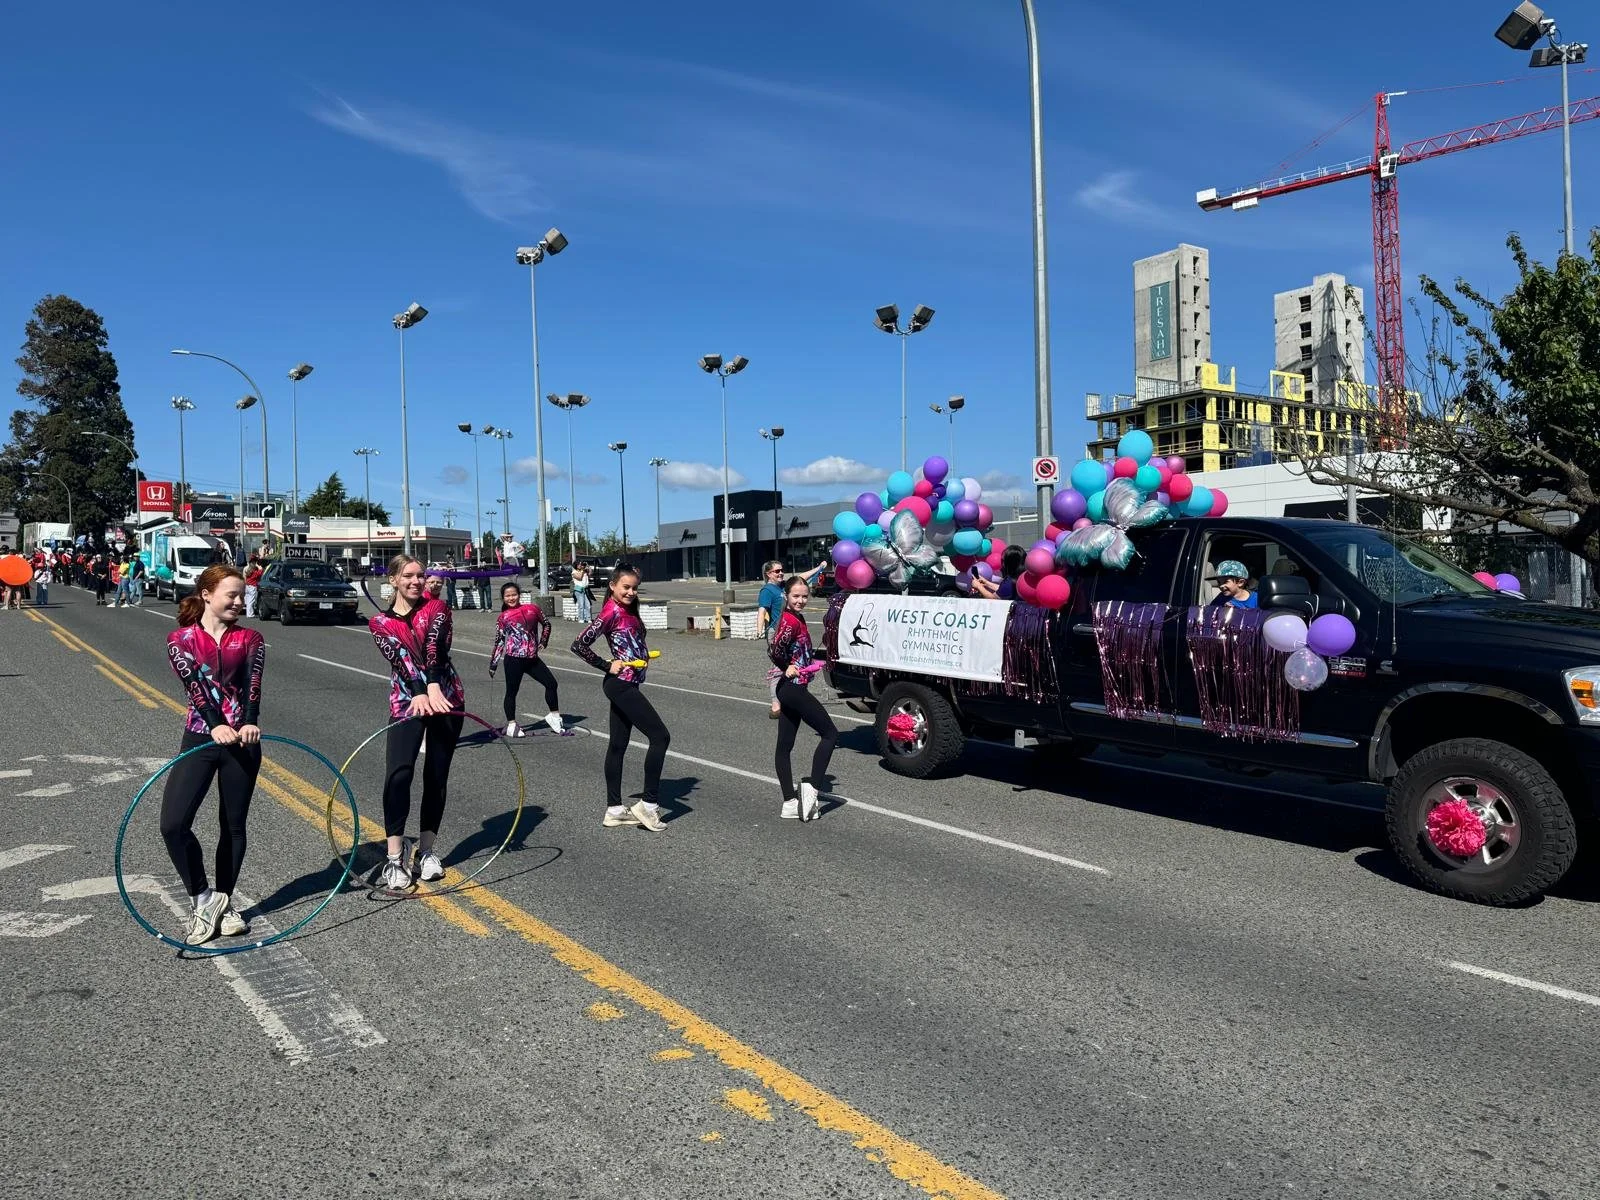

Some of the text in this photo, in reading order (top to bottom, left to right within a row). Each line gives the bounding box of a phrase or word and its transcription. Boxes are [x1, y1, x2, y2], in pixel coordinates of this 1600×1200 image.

[1156, 285, 1165, 349] TRESAH
[288, 549, 319, 558] ON AIR
[582, 617, 604, 644] COAST
[887, 608, 991, 631] WEST COAST
[907, 626, 959, 642] RHYTHMIC
[901, 639, 963, 656] GYMNASTICS
[168, 640, 206, 709] WES COAST
